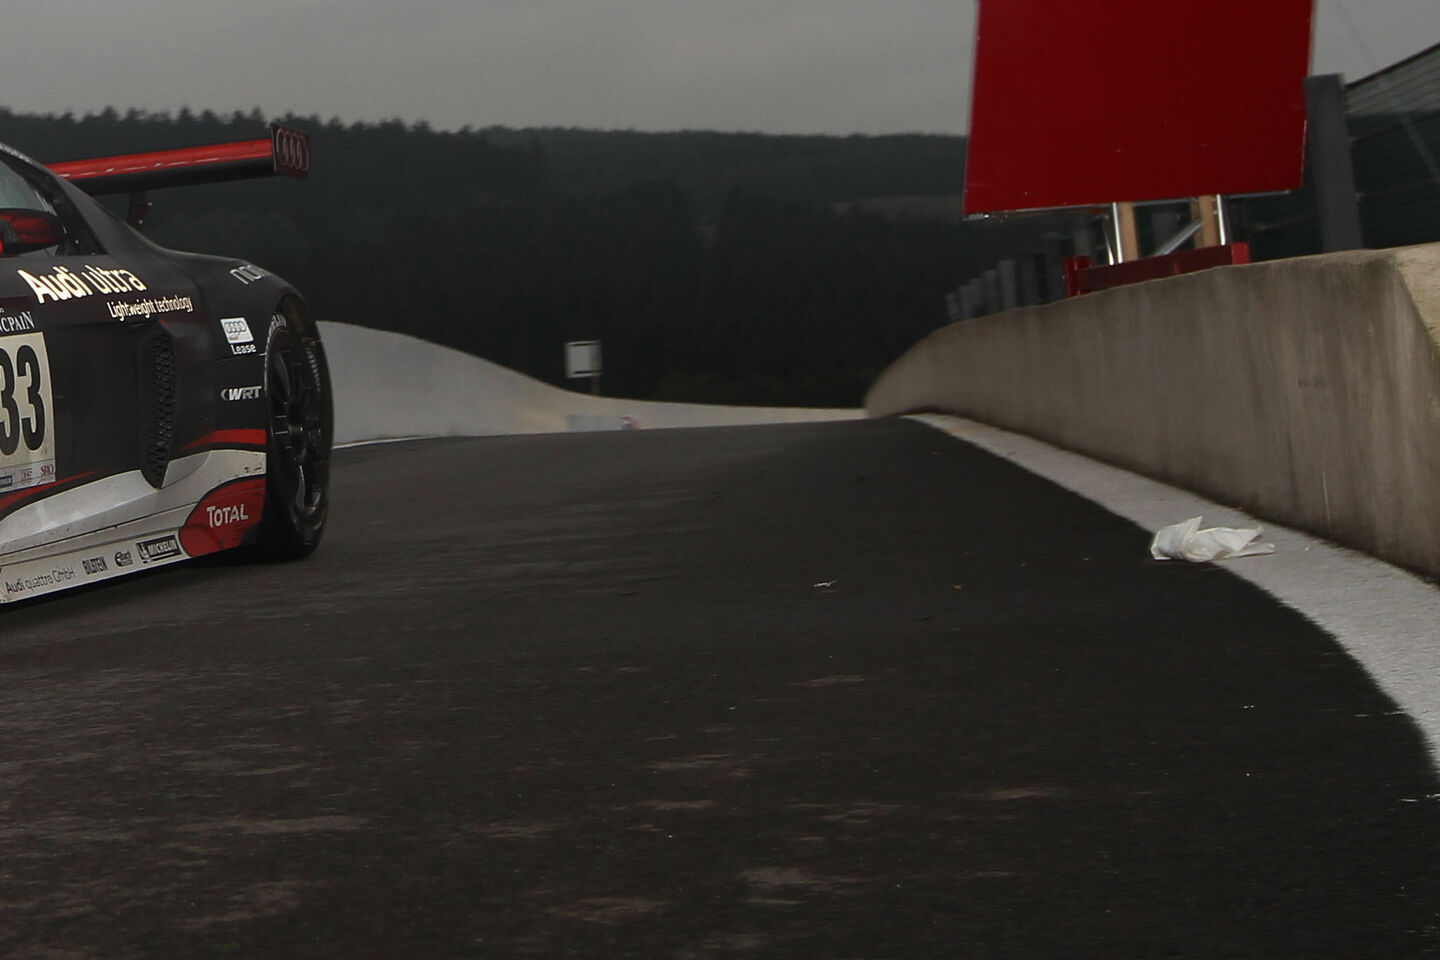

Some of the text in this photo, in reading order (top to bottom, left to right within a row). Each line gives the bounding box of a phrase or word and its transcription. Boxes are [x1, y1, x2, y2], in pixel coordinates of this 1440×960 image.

[17, 264, 148, 304] Audi ultra
[106, 294, 194, 322] Lightweight technology
[230, 343, 257, 355] Lease
[206, 503, 249, 529] TOTAL
[5, 567, 76, 593] Audi quattro GmbH
